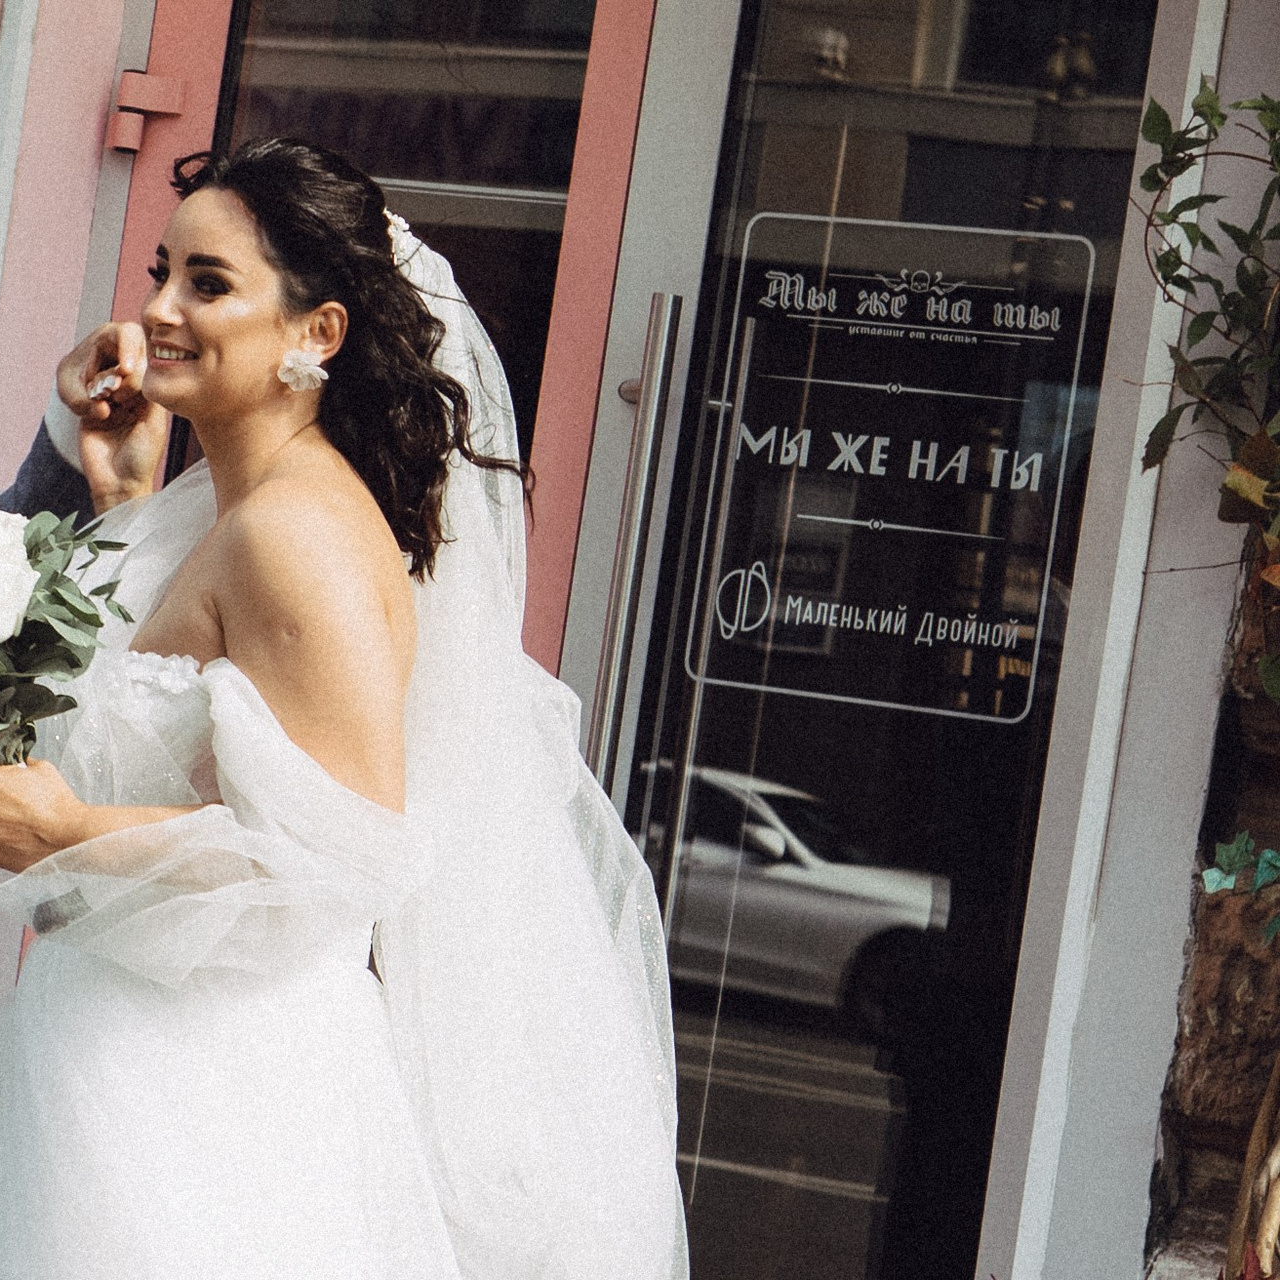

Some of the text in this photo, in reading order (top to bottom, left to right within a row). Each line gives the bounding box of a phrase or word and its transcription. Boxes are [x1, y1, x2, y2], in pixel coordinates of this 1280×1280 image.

[758, 270, 1062, 332] Мы же на ты
[736, 422, 1044, 492] МЫ ЖЕ НА ТЫ
